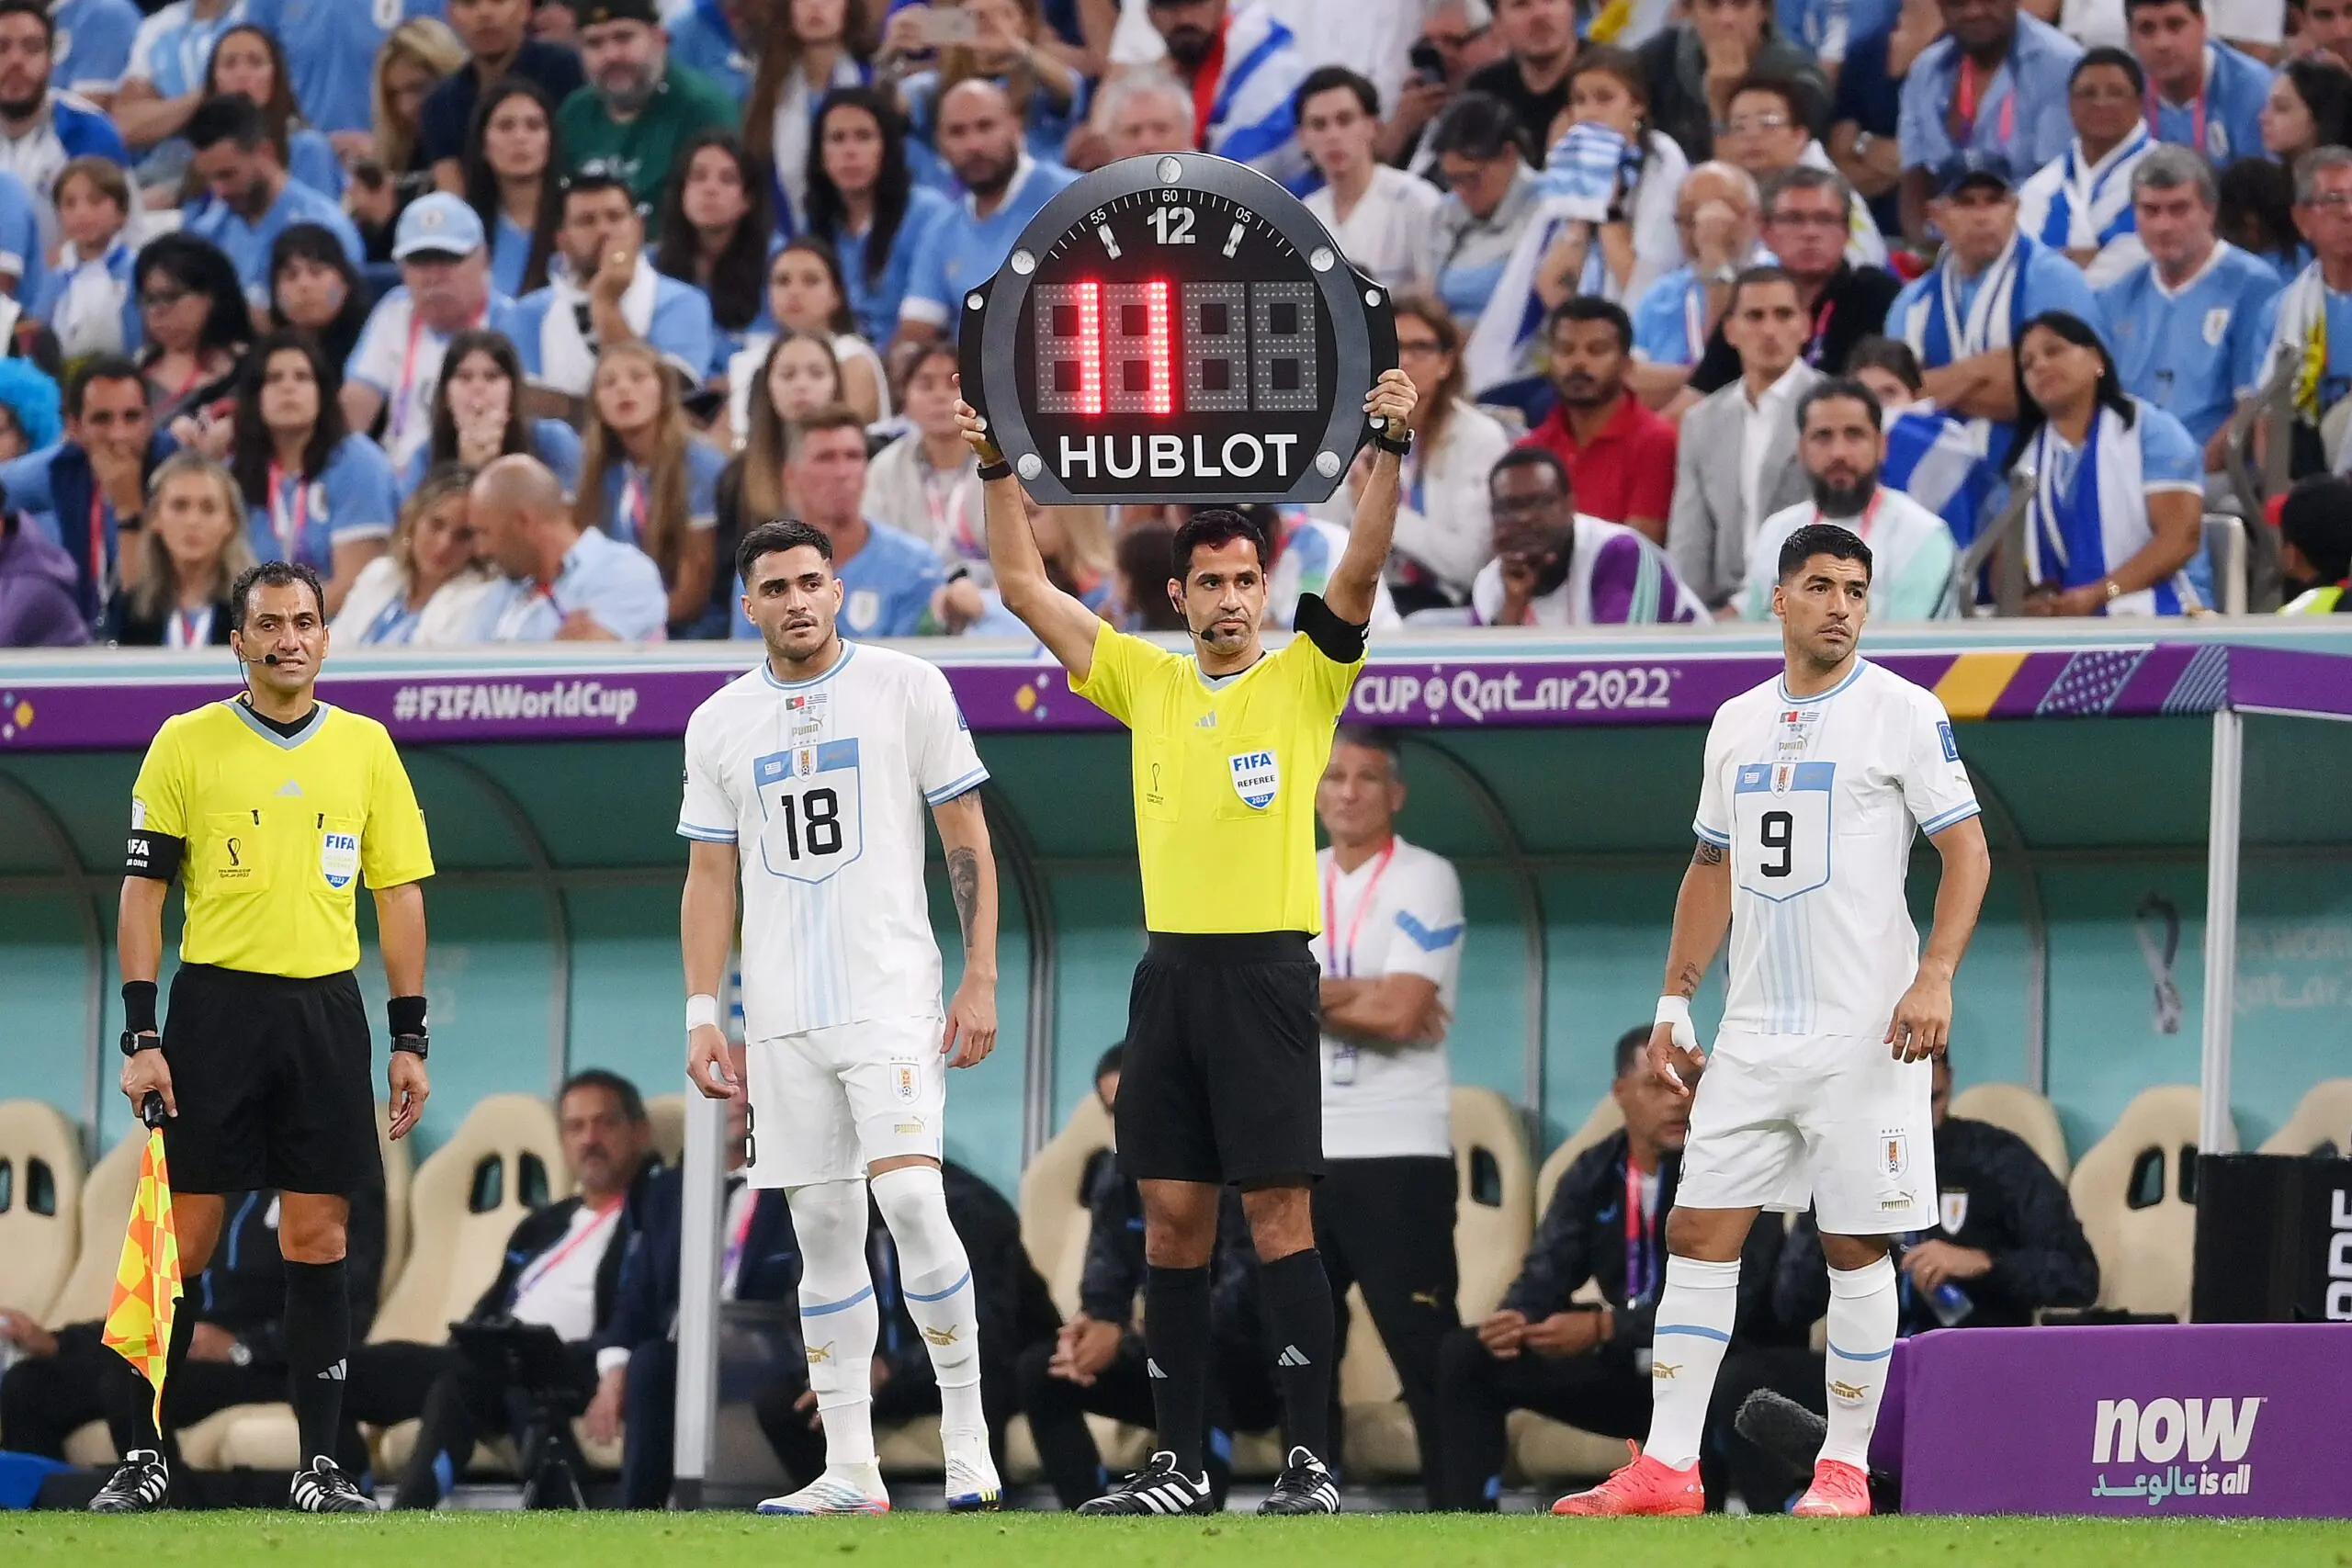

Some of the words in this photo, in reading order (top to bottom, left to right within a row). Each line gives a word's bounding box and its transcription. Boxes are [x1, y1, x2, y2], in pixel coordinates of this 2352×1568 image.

[1161, 190, 1179, 202] 60
[1090, 208, 1107, 224] 55
[1235, 207, 1253, 223] 05
[1147, 207, 1195, 244] 12
[1080, 280, 1172, 415] 11
[1059, 434, 1298, 479] HUBLOT
[393, 681, 638, 725] #FIFAWorldCup
[1353, 675, 1420, 714] CUP
[1233, 752, 1272, 772] FIFA
[1238, 774, 1275, 788] REFEREE
[1251, 795, 1269, 804] 2022
[781, 787, 842, 860] 18
[128, 839, 150, 855] IFA
[326, 835, 355, 851] FIFA
[1760, 811, 1793, 877] 9
[331, 876, 345, 885] 2022
[1882, 1200, 1910, 1211] PUMA
[2092, 1397, 2260, 1463] now
[2199, 1464, 2219, 1495] is
[2222, 1463, 2251, 1495] all
